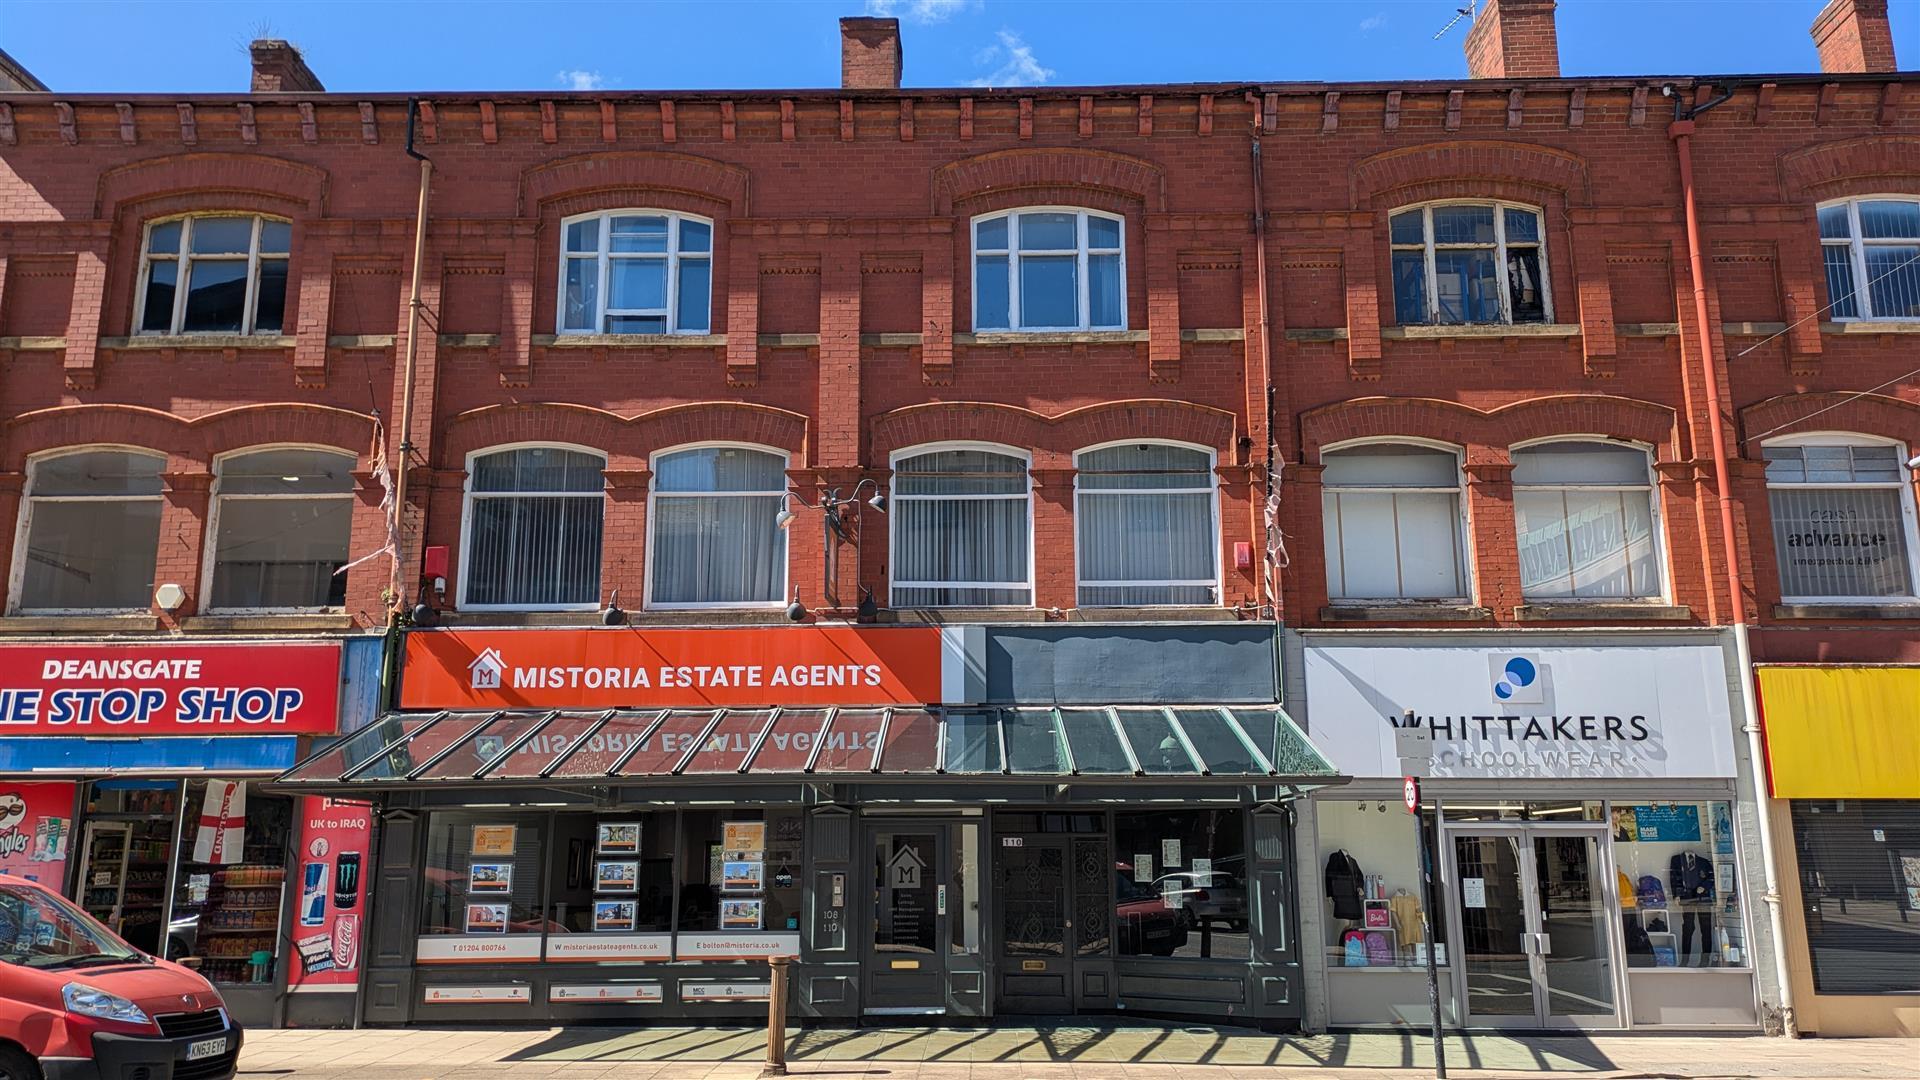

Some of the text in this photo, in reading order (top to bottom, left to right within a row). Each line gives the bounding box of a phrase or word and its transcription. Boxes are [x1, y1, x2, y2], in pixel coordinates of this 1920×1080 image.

[1788, 529, 1886, 547] advance
[42, 659, 202, 680] DEANSGATE
[513, 665, 881, 688] MISTORIA ESTATE AGENTS
[48, 687, 166, 724] STOP
[176, 687, 303, 724] SHOP
[213, 795, 231, 854] ENGLAND
[310, 818, 366, 830] UK to IRAQ
[1004, 838, 1022, 846] 110
[823, 910, 839, 919] 108
[823, 922, 838, 932] 110
[458, 944, 480, 952] 01204
[481, 944, 507, 952] 800766
[554, 943, 658, 952] W mistoriaestateagents.co.uk
[191, 1042, 211, 1057] KN63
